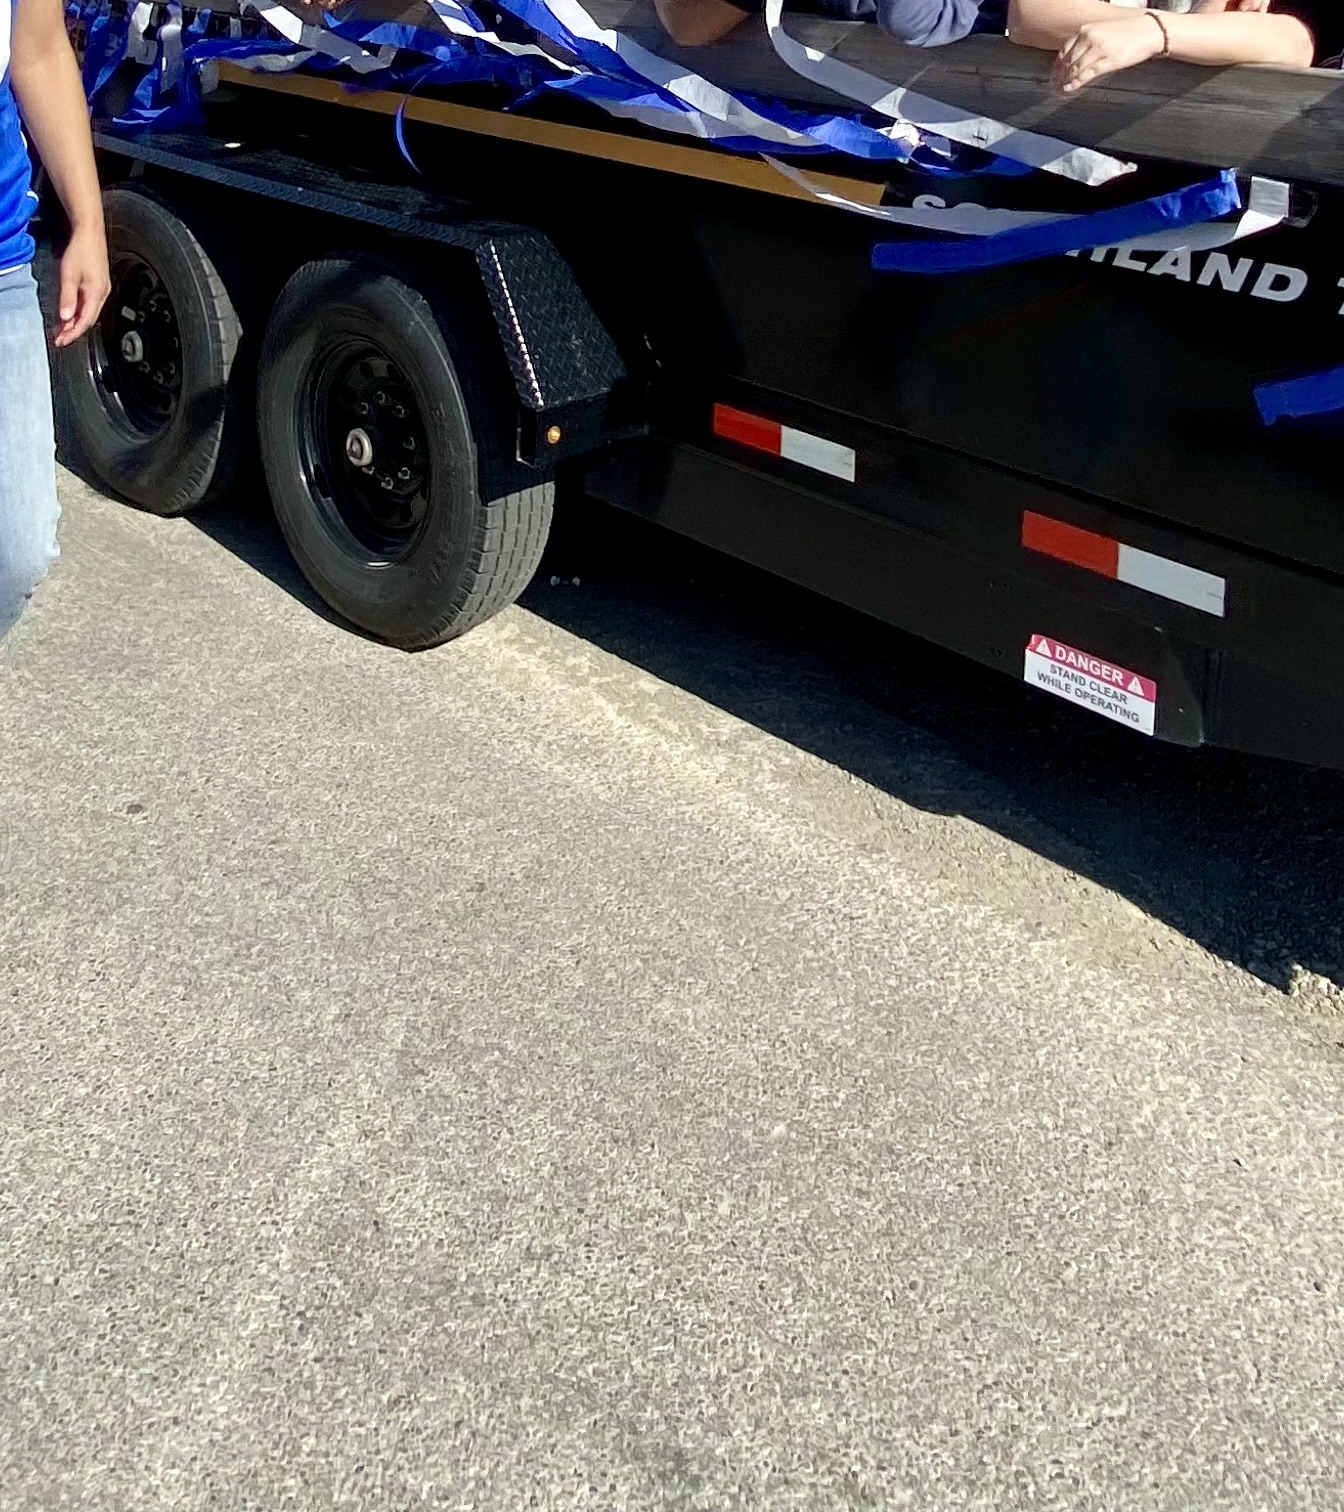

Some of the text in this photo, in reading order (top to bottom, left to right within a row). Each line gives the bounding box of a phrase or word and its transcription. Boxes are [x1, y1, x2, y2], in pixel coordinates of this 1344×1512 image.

[1050, 663, 1128, 705] STAND CLEAR
[1055, 645, 1124, 686] DANGER
[1037, 671, 1140, 724] WHILE OPERATING
